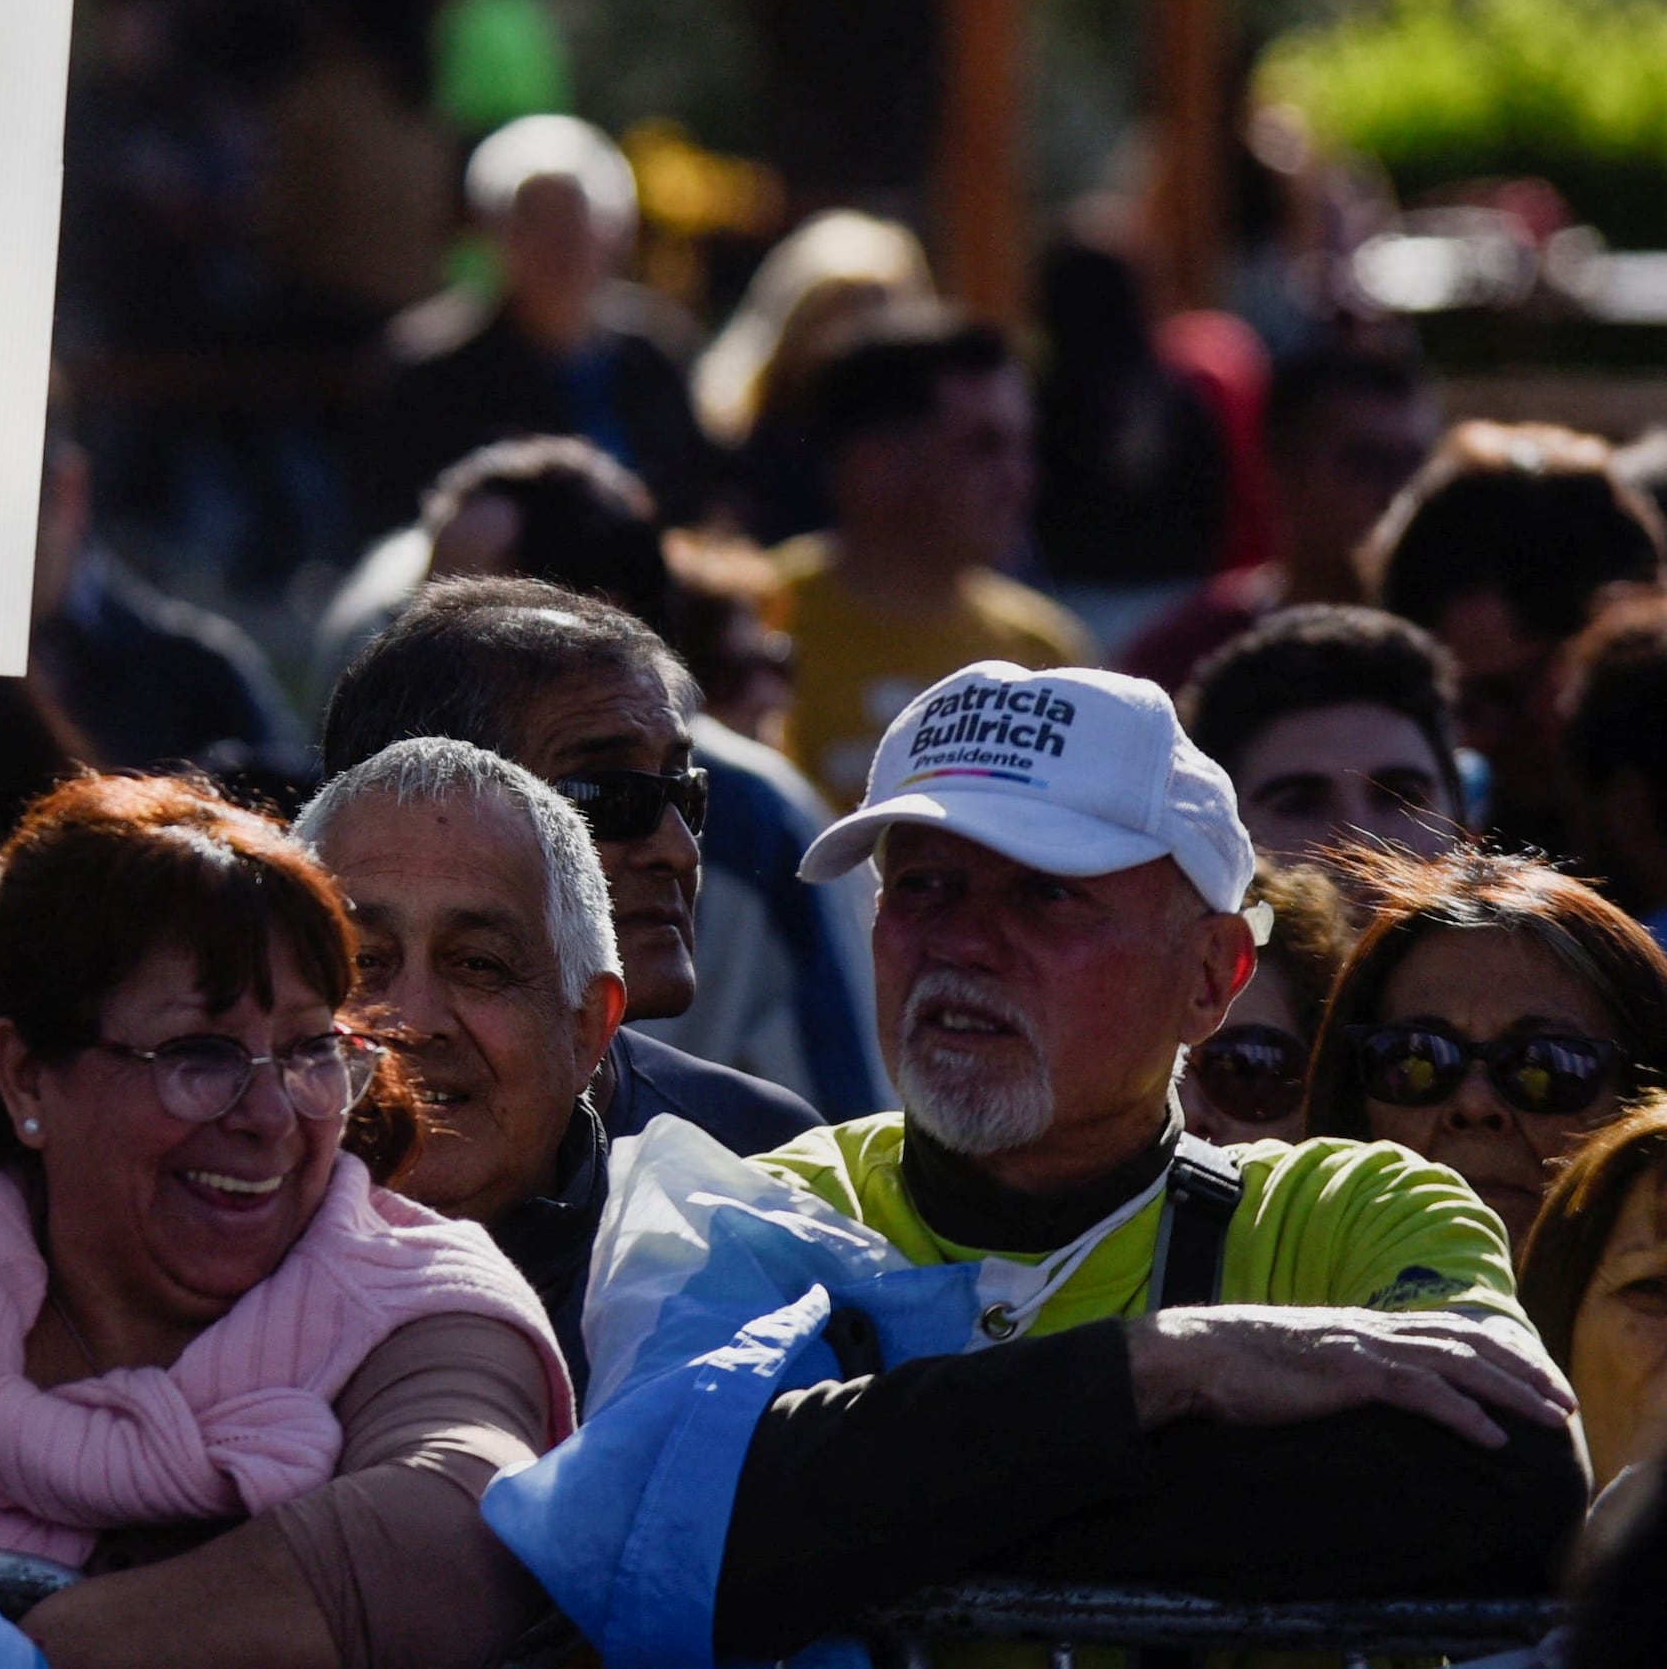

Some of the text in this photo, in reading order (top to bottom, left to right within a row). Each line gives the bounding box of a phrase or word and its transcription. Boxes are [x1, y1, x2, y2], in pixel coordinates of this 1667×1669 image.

[920, 683, 1075, 726] Patricia
[910, 715, 1065, 758] Bullrich
[913, 748, 1034, 771] Presidente
